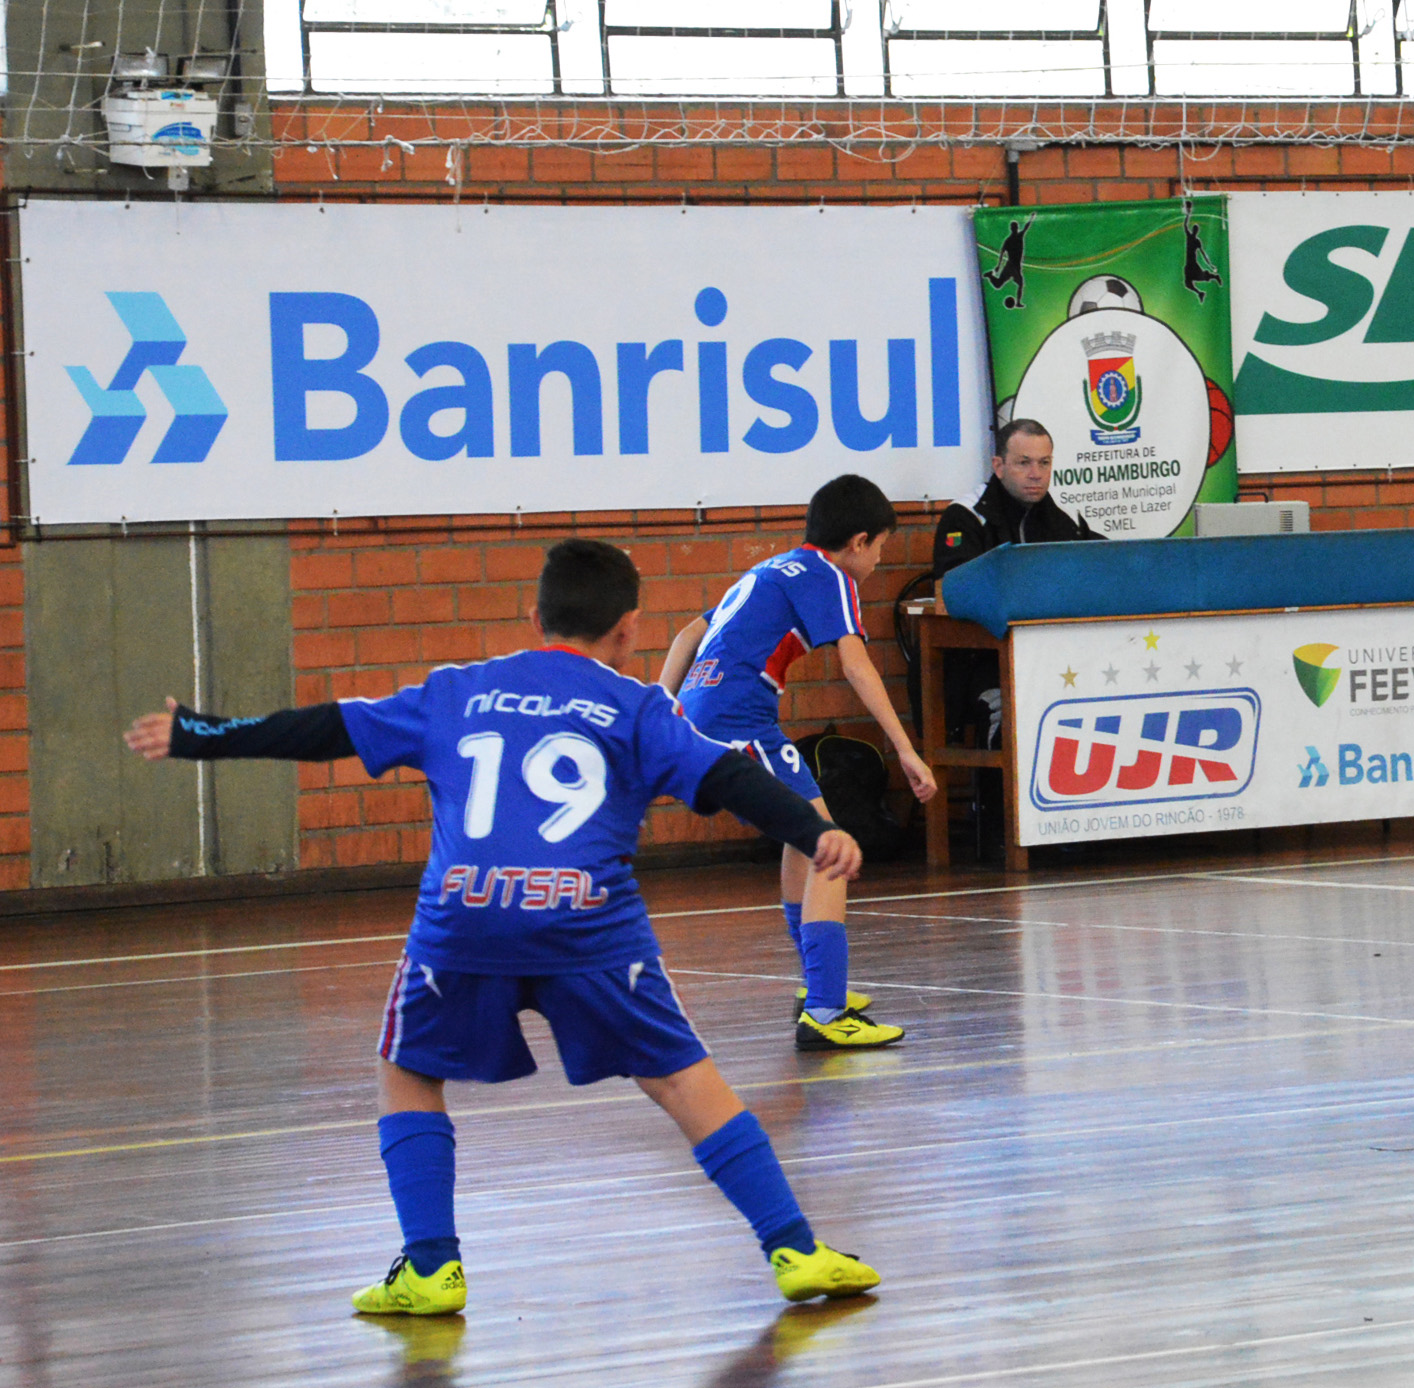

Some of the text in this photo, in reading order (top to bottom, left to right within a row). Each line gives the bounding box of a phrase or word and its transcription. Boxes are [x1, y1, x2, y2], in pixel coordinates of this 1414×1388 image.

[269, 277, 961, 461] Banrisul
[1076, 446, 1157, 463] PREFEITURA DE
[1053, 460, 1181, 486] NOVO HAMBURGO
[1060, 483, 1177, 505] Secretaria Municipal
[1084, 500, 1172, 520] Esporte e Lazer
[1103, 518, 1136, 532] SMEL
[697, 572, 758, 658] 9
[1350, 704, 1409, 717] CONHECIMENTO
[780, 744, 801, 773] 9
[1048, 707, 1243, 797] UJR
[457, 731, 607, 844] 19
[1038, 818, 1080, 836] UNIÃO
[1084, 815, 1129, 833] JOVEM
[1132, 813, 1151, 828] DO
[1217, 806, 1245, 822] 1978
[438, 864, 609, 909] FUTSAL
